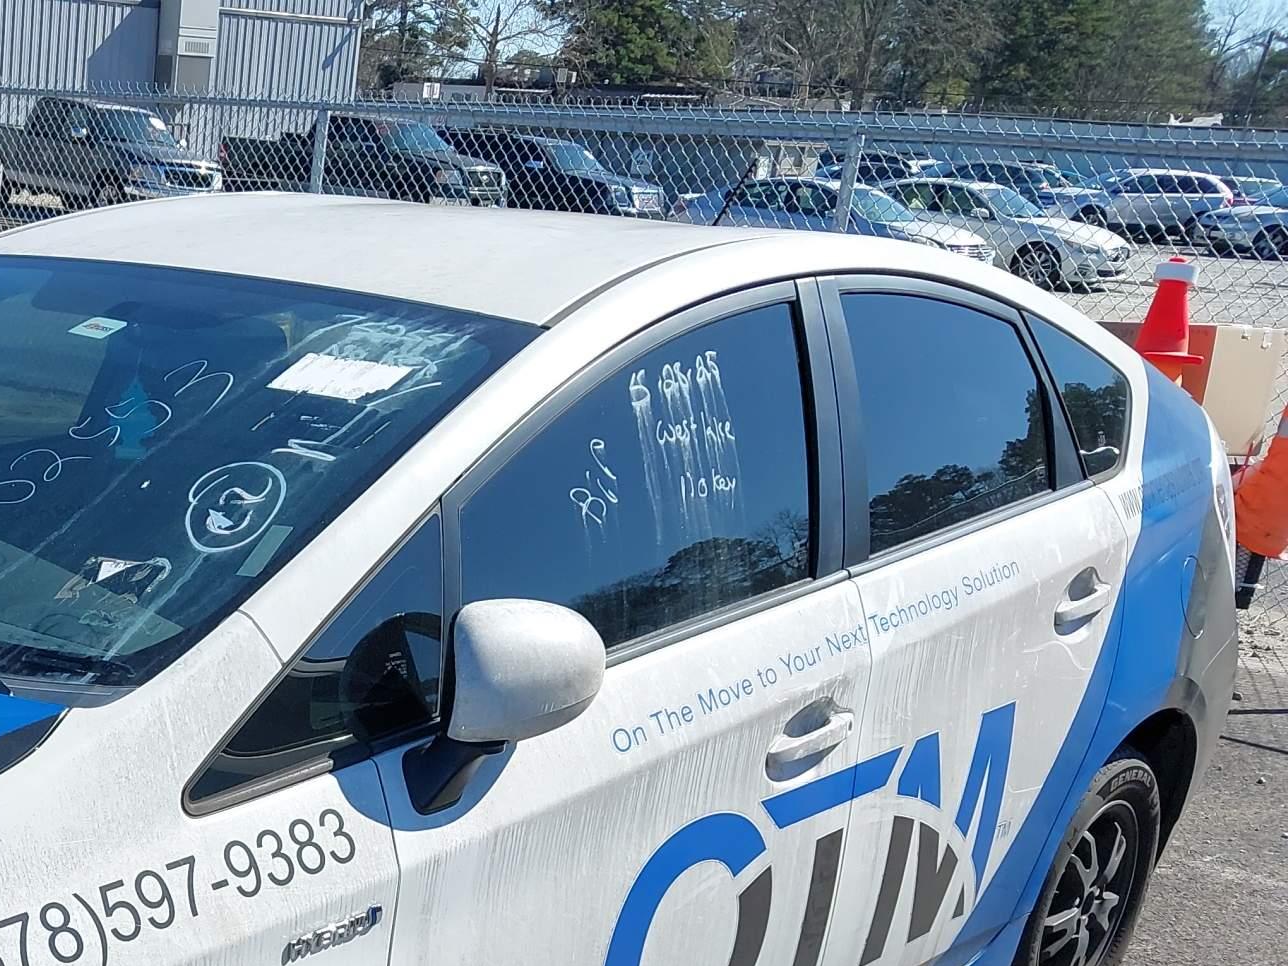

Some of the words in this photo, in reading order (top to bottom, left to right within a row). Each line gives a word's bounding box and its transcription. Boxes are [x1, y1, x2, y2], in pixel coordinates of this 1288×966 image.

[612, 725, 648, 753] On
[649, 705, 694, 734] The
[697, 678, 754, 715] Move
[756, 667, 778, 688] to
[779, 646, 822, 676] Your
[824, 623, 868, 656] Next
[868, 585, 959, 636] Technology
[961, 560, 1020, 596] Solution
[1109, 768, 1152, 792] GENERAL
